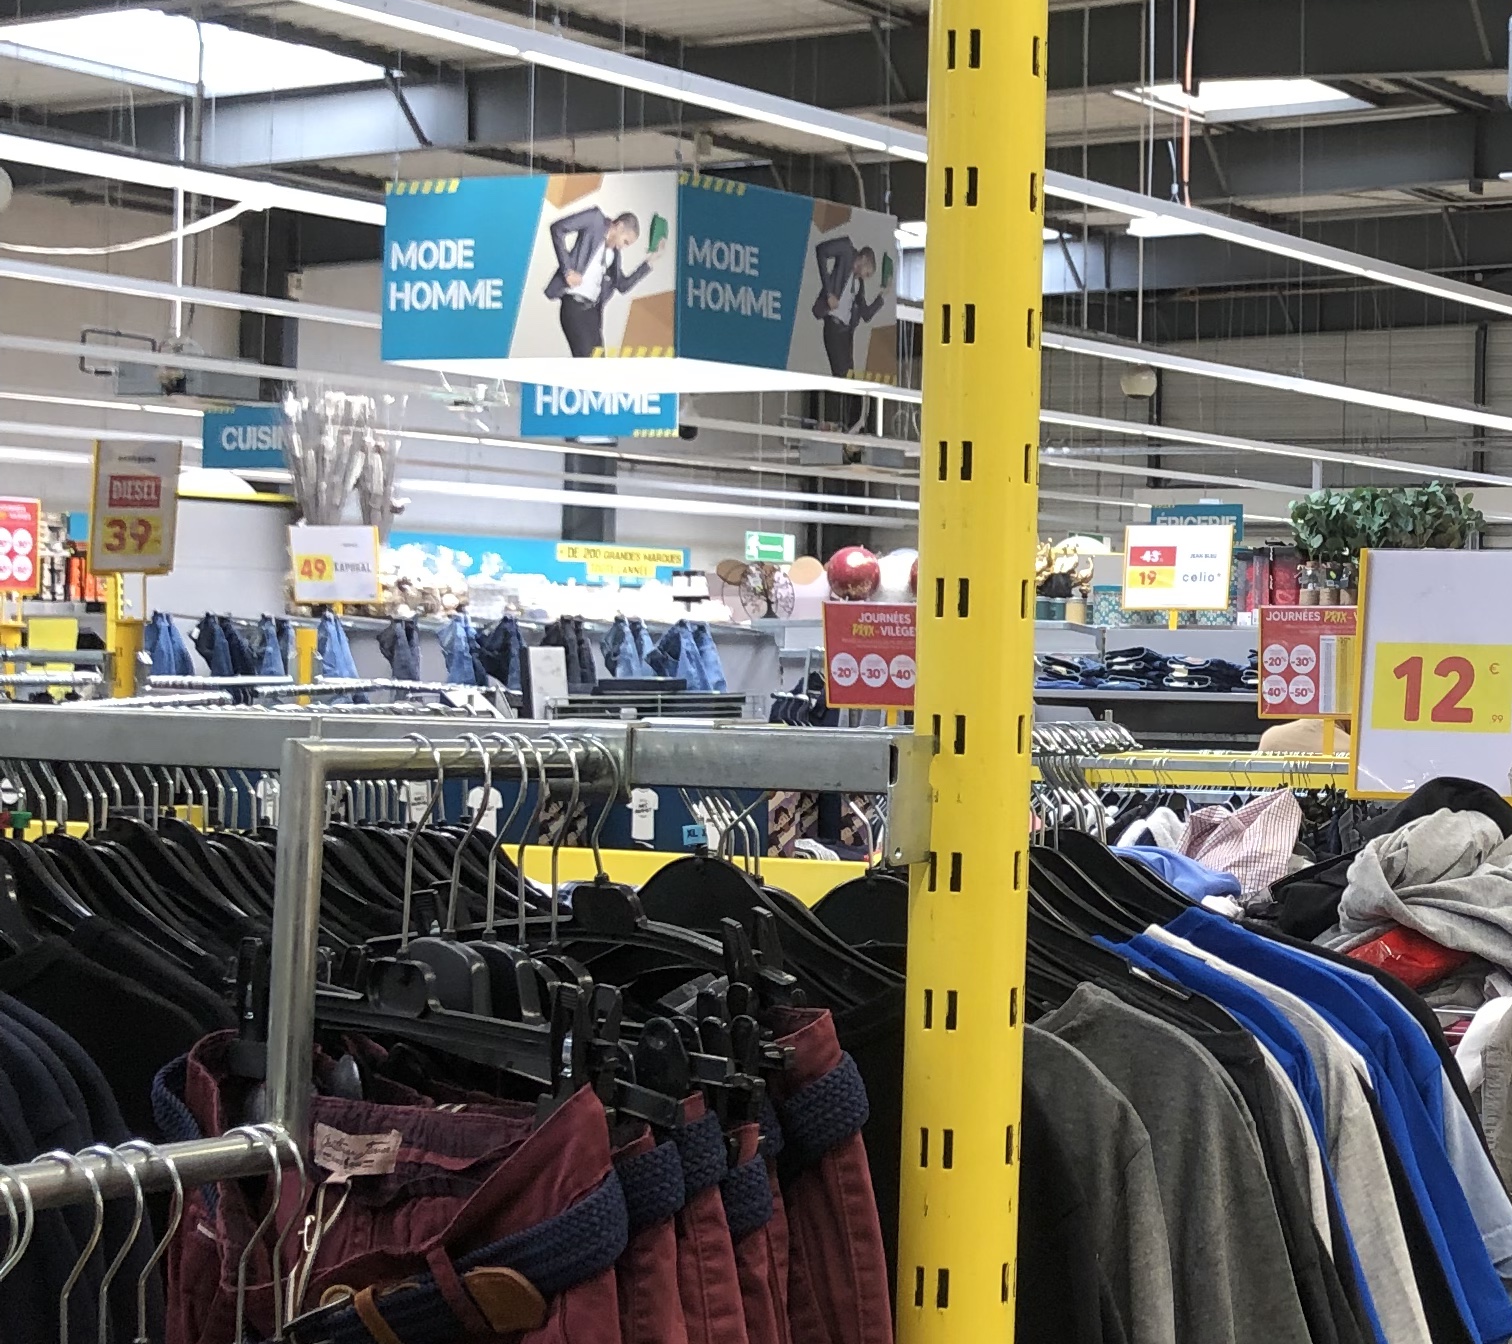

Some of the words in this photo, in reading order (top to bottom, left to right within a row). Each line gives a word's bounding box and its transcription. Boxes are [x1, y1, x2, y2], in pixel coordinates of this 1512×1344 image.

[390, 238, 475, 272] MODE
[688, 235, 759, 277] MODE
[389, 278, 503, 312] HOMME
[687, 277, 782, 321] HOMME
[534, 386, 662, 416] HOMME
[221, 425, 287, 451] CUISIN
[111, 479, 159, 502] DIESEL
[105, 519, 152, 552] 39
[301, 558, 327, 580] 49
[1139, 570, 1157, 585] 19
[858, 611, 912, 624] JOURNÉES
[1265, 609, 1321, 622] JOURNÉES
[1393, 656, 1475, 724] 12
[686, 828, 699, 838] XL
